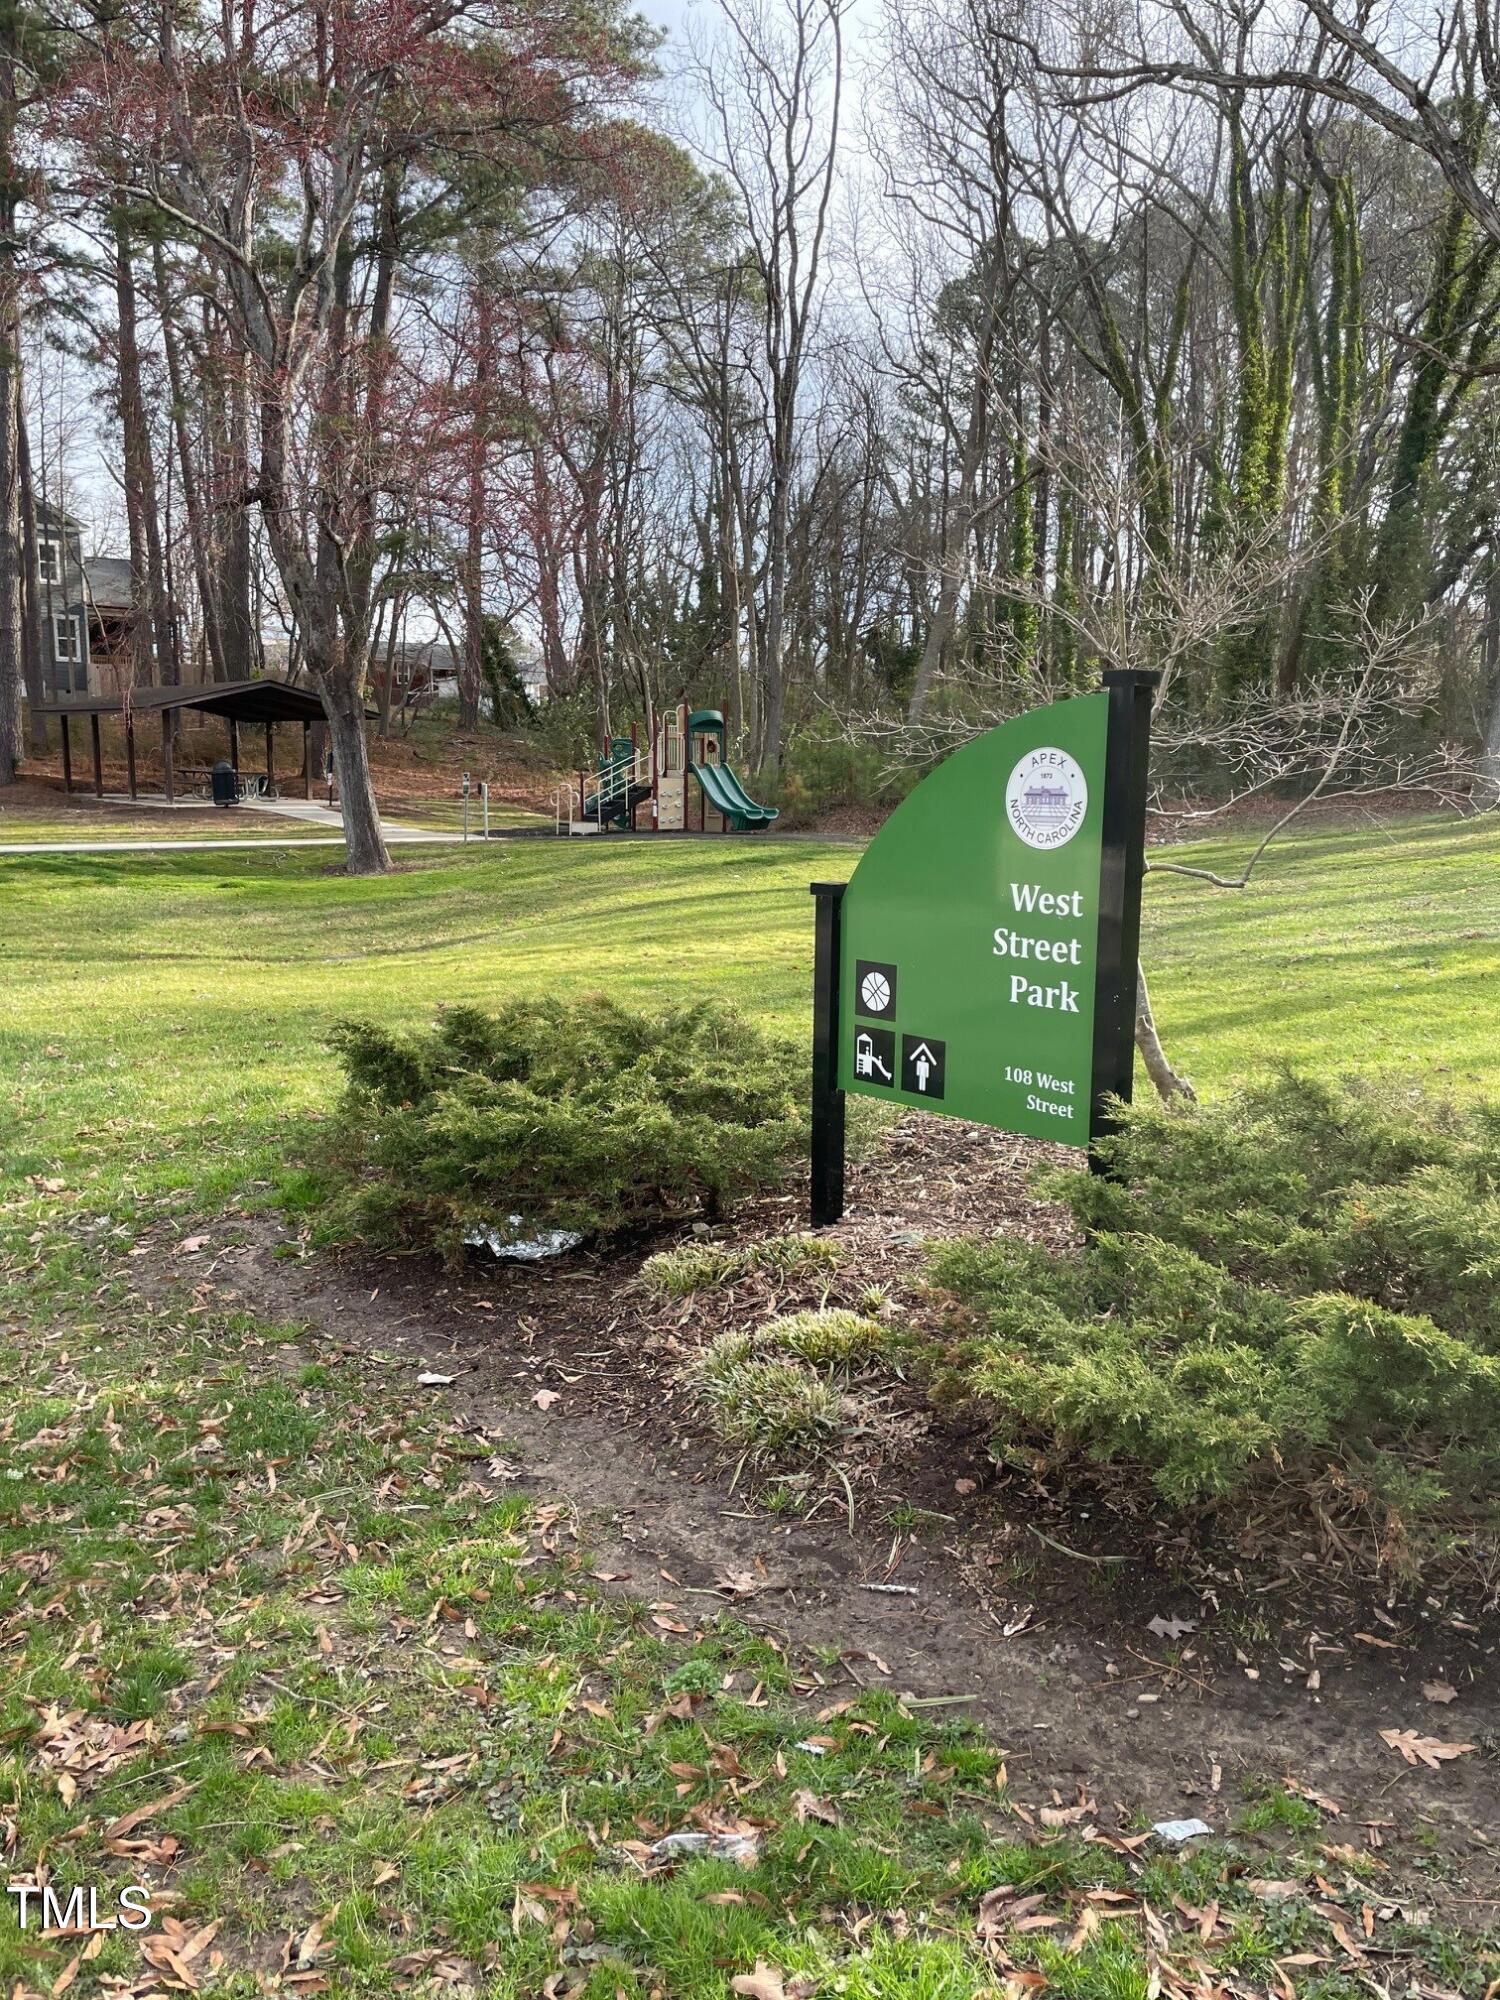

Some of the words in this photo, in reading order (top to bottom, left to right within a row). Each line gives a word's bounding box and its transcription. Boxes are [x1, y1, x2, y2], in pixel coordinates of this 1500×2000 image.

[1032, 753, 1068, 769] APEX
[1010, 799, 1035, 839] NORTH
[1037, 800, 1083, 843] CAROLINA
[1009, 882, 1084, 919] West
[992, 927, 1082, 966] Street
[1009, 974, 1080, 1013] Park
[1004, 1065, 1033, 1085] 108
[1036, 1072, 1075, 1095] West
[1026, 1094, 1075, 1119] Street
